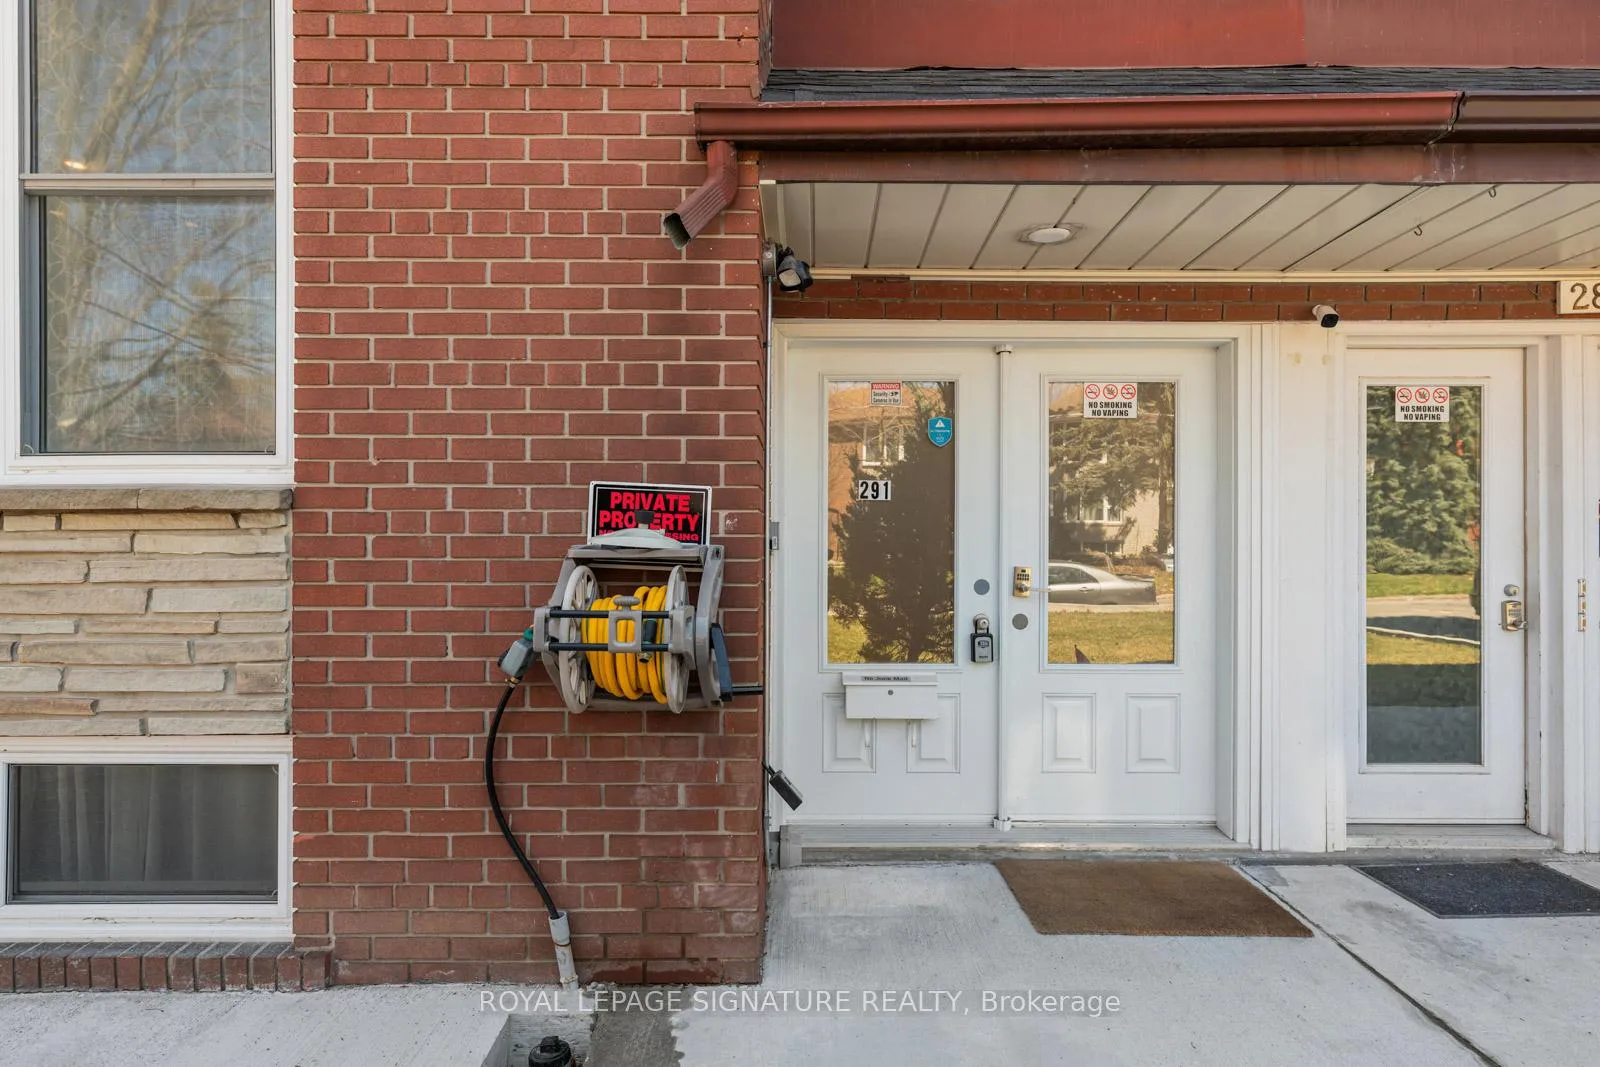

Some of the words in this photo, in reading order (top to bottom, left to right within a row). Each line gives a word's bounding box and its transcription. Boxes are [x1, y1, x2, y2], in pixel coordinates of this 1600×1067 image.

[1088, 401, 1098, 409] NO
[1099, 401, 1133, 409] SMOKING
[1400, 405, 1410, 413] NO
[1411, 405, 1445, 413] SMOKING
[1414, 413, 1441, 421] VAPING
[860, 481, 889, 500] 291
[610, 491, 691, 512] PRIVATE
[599, 510, 700, 532] PROERTY
